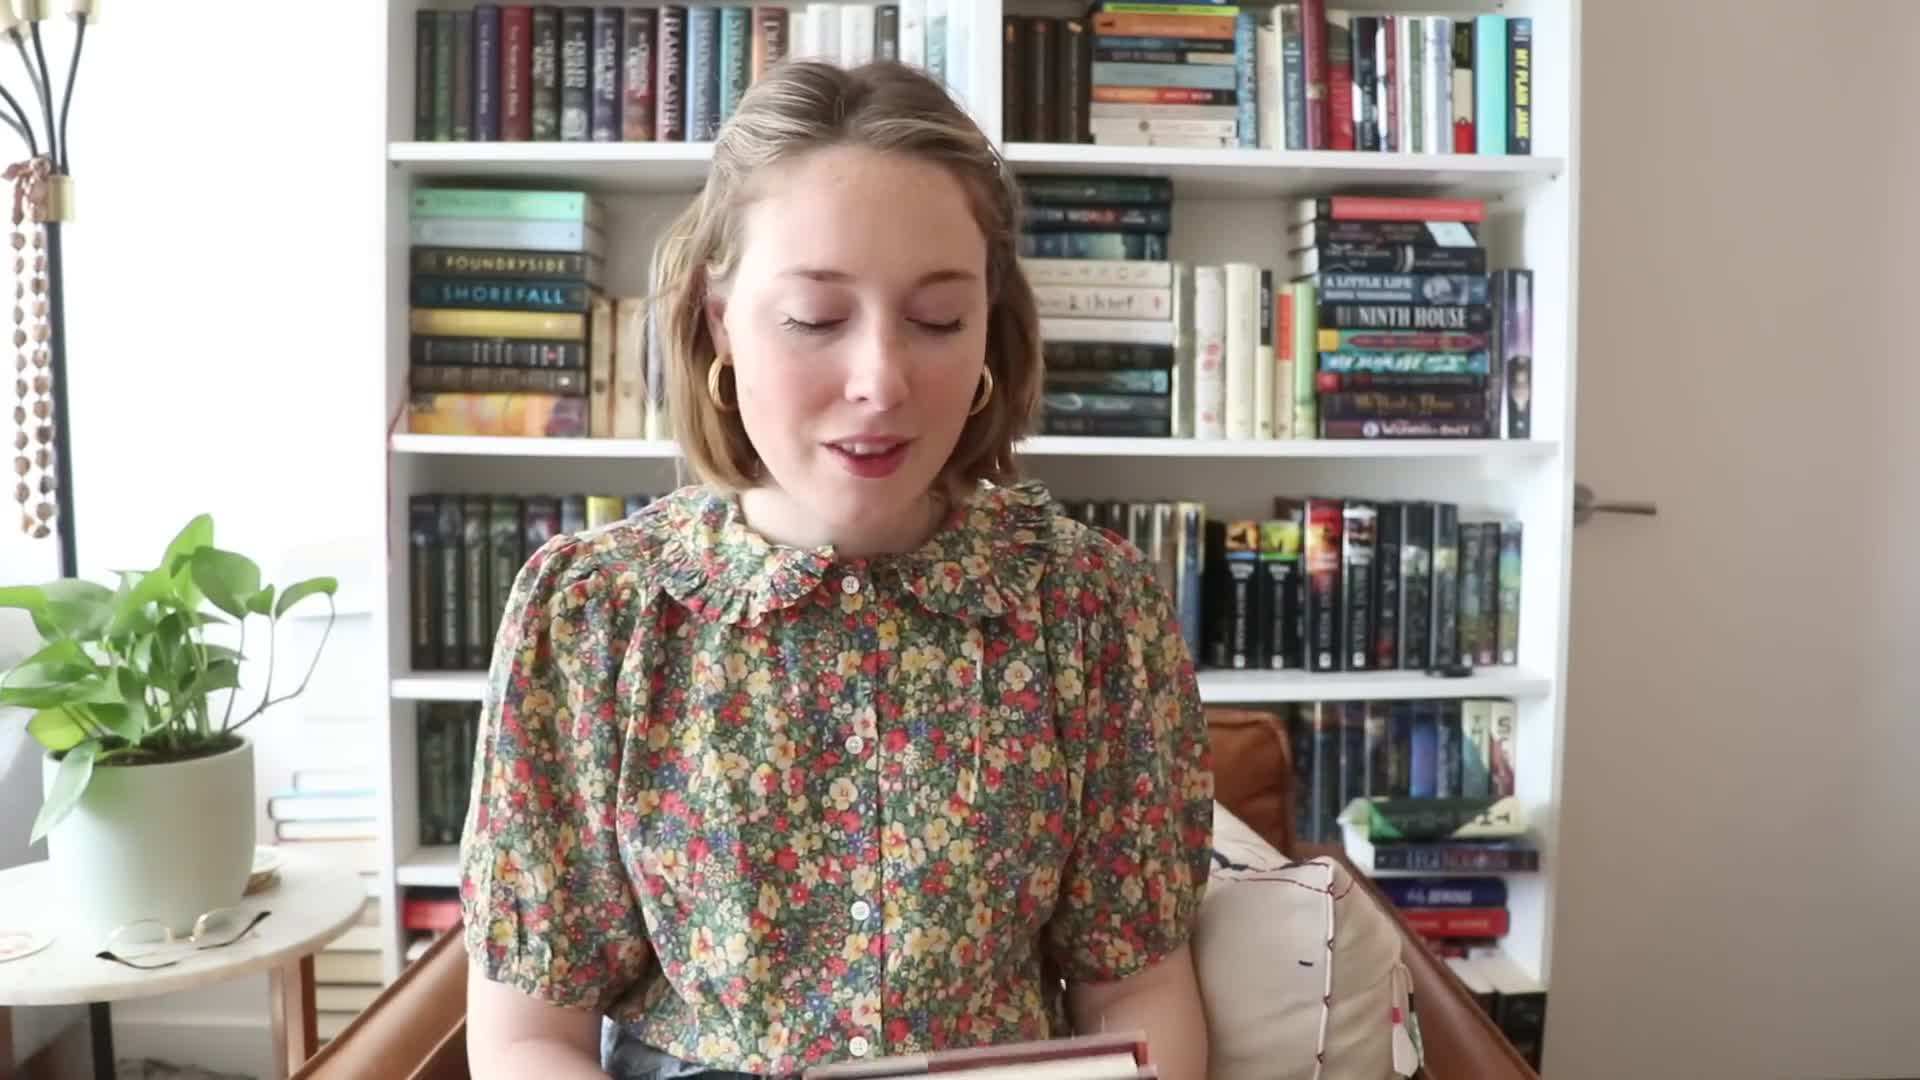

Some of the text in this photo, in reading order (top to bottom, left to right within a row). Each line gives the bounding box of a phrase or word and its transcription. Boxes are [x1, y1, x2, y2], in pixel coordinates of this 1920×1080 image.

[1515, 48, 1528, 66] MY
[1515, 70, 1528, 106] PLAIN
[1515, 108, 1529, 140] JANE
[447, 255, 567, 272] FOUNDRYSIDE
[1383, 276, 1412, 288] LIFE
[442, 285, 564, 304] SHOREFALL
[1358, 306, 1411, 327] NINTH
[1413, 306, 1465, 328] HOUSE
